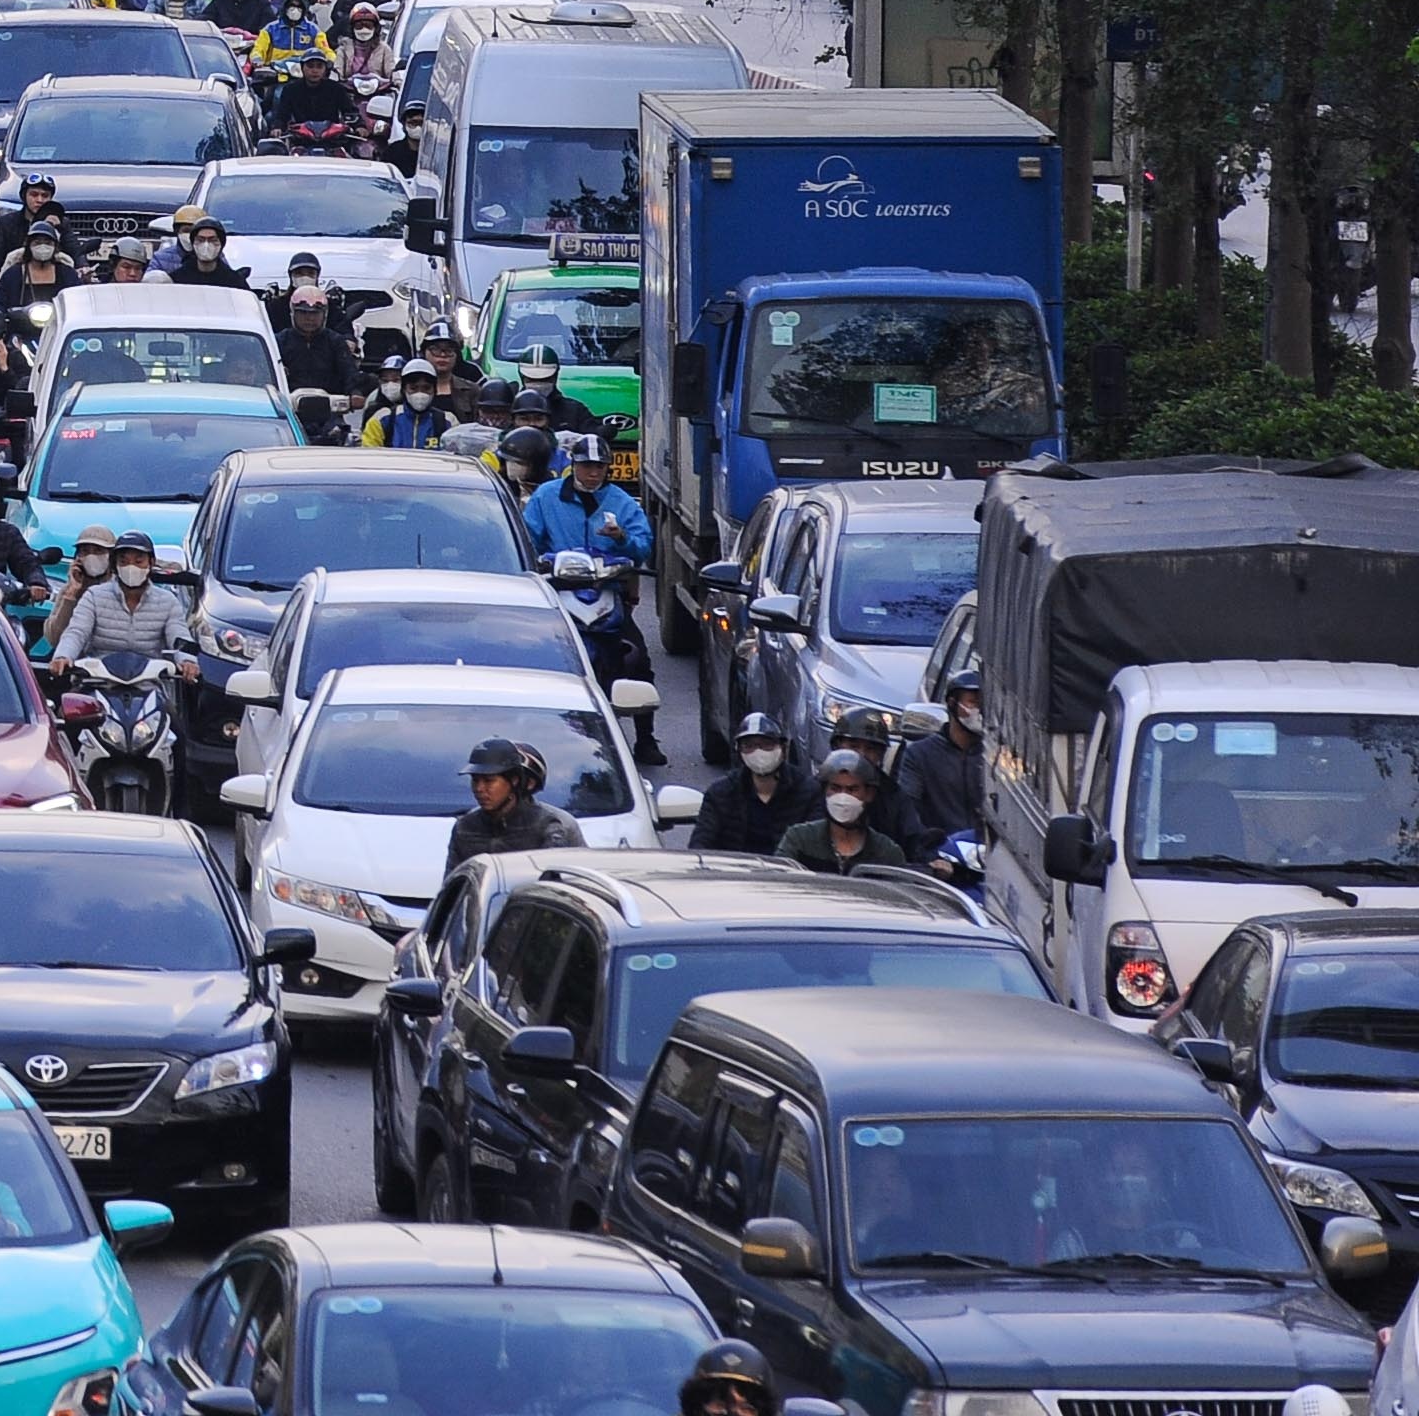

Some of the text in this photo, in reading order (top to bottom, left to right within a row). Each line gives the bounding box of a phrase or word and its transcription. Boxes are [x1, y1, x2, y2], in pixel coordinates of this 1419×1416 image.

[825, 195, 869, 218] SÓC
[875, 204, 951, 217] LOGISTICS
[583, 242, 605, 257] SAO
[62, 429, 96, 439] TAXI
[863, 461, 939, 475] ISUZU
